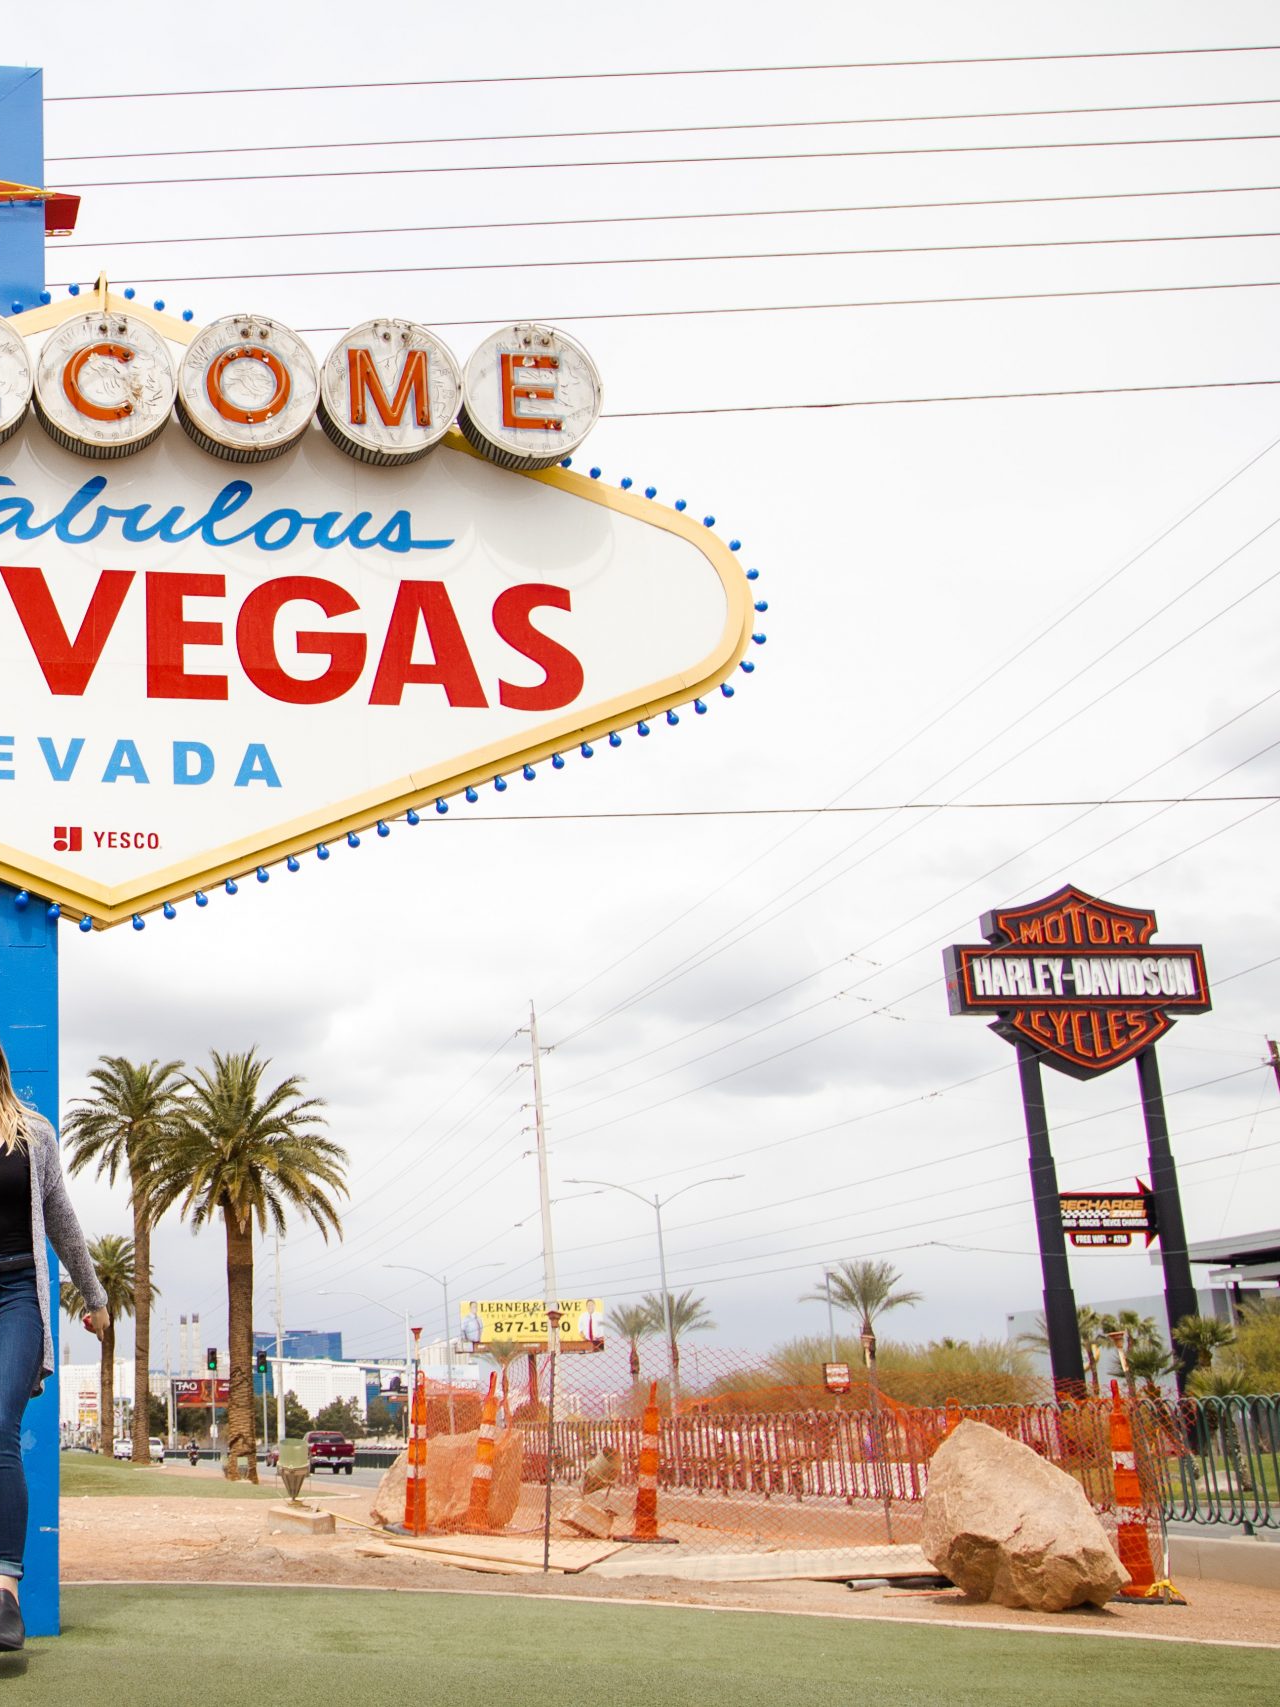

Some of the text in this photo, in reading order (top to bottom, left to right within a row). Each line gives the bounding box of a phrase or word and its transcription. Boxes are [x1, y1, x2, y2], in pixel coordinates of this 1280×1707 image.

[0, 566, 583, 711] VEGAS
[93, 831, 160, 850] YESCO
[1020, 902, 1135, 944] MOTOR
[973, 957, 1195, 996] HARLEY-DAVIDSON
[1031, 1010, 1147, 1058] CYCLES
[494, 1321, 571, 1333] 877-150
[175, 1382, 198, 1391] TAO
